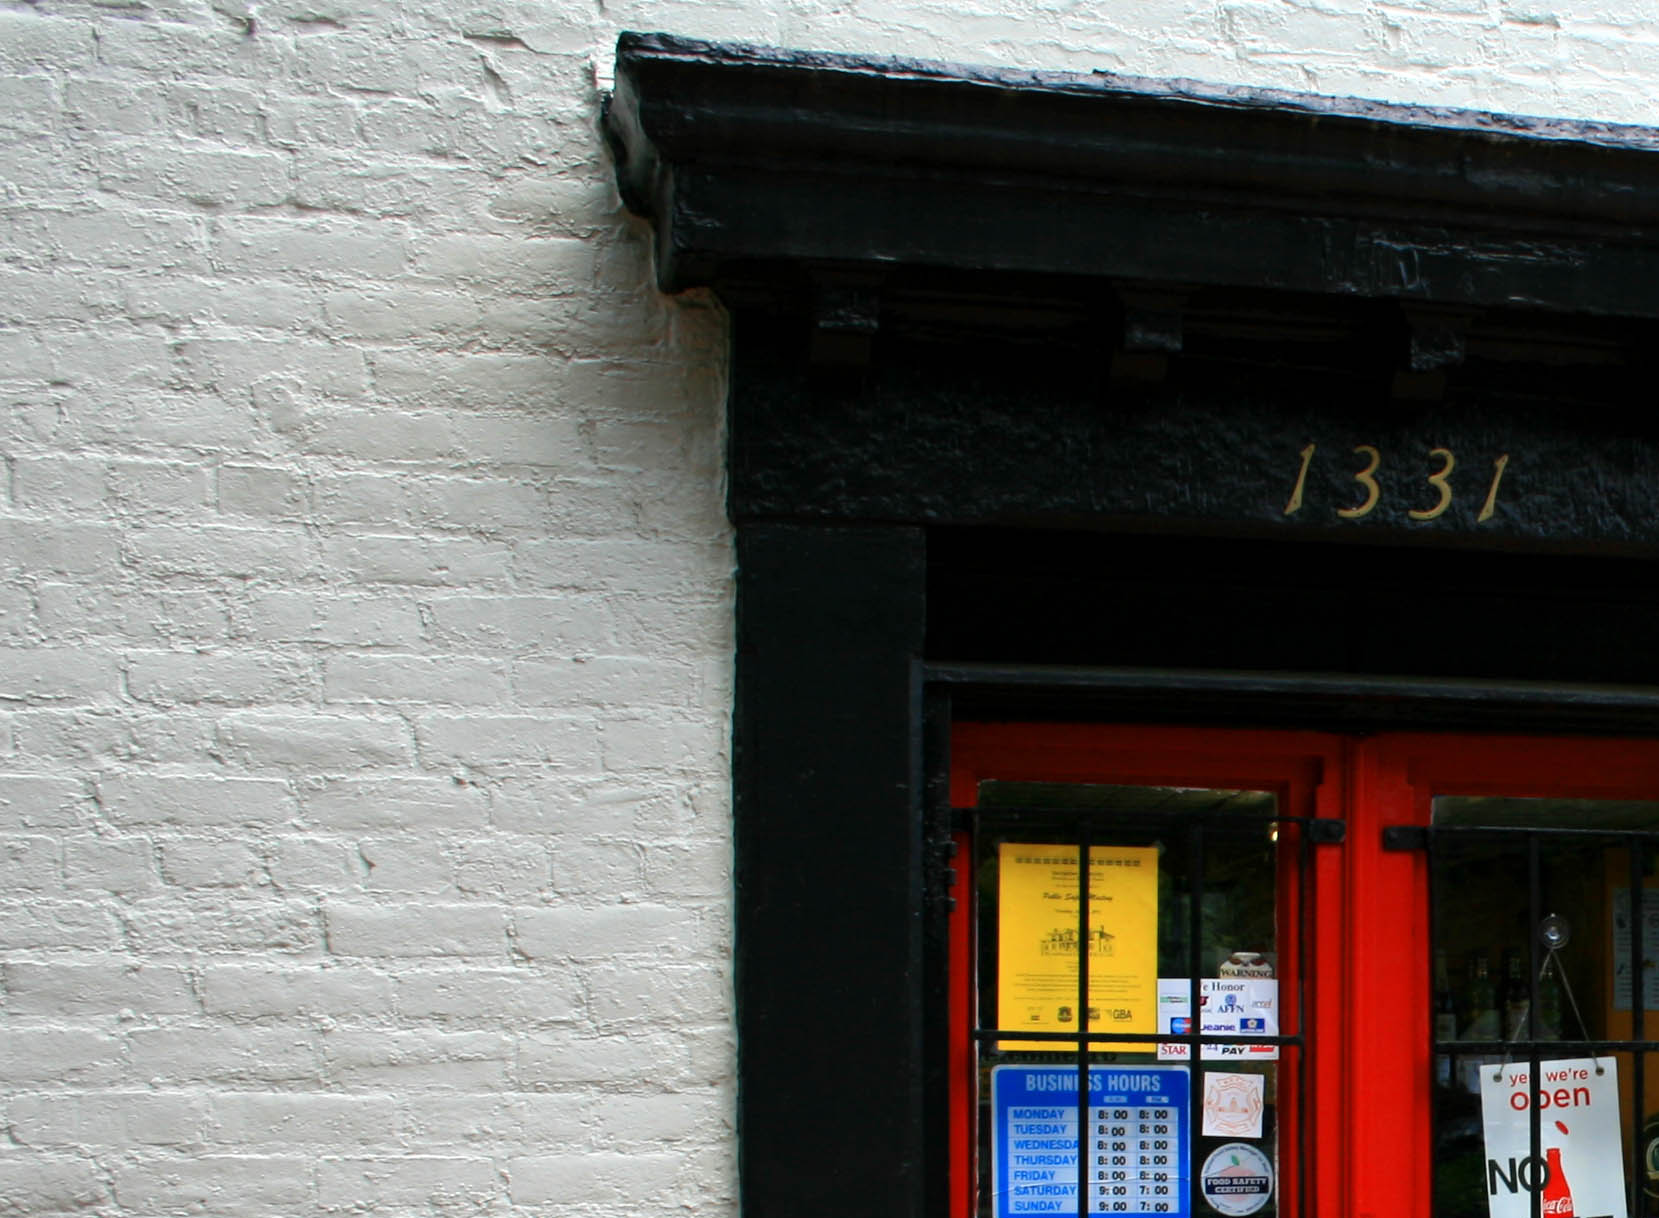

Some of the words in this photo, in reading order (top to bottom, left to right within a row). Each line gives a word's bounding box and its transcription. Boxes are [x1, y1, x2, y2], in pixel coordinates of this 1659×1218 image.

[1283, 443, 1509, 523] 1331
[1212, 981, 1245, 992] Honor
[1221, 1047, 1246, 1056] PAY
[1545, 1068, 1588, 1082] we're
[1107, 1075, 1161, 1091] HOURS
[1013, 1109, 1065, 1119] MONDAY
[1013, 1124, 1067, 1134] TUESDAY
[1014, 1140, 1079, 1150] WEDNESDA
[1014, 1155, 1078, 1165] THURSDAY
[1014, 1170, 1056, 1181] FRIDAY
[1488, 1156, 1551, 1195] NO
[1232, 1177, 1267, 1185] SAFETY
[1014, 1185, 1077, 1196] SATURDAY
[1014, 1201, 1063, 1211] SUNDAY
